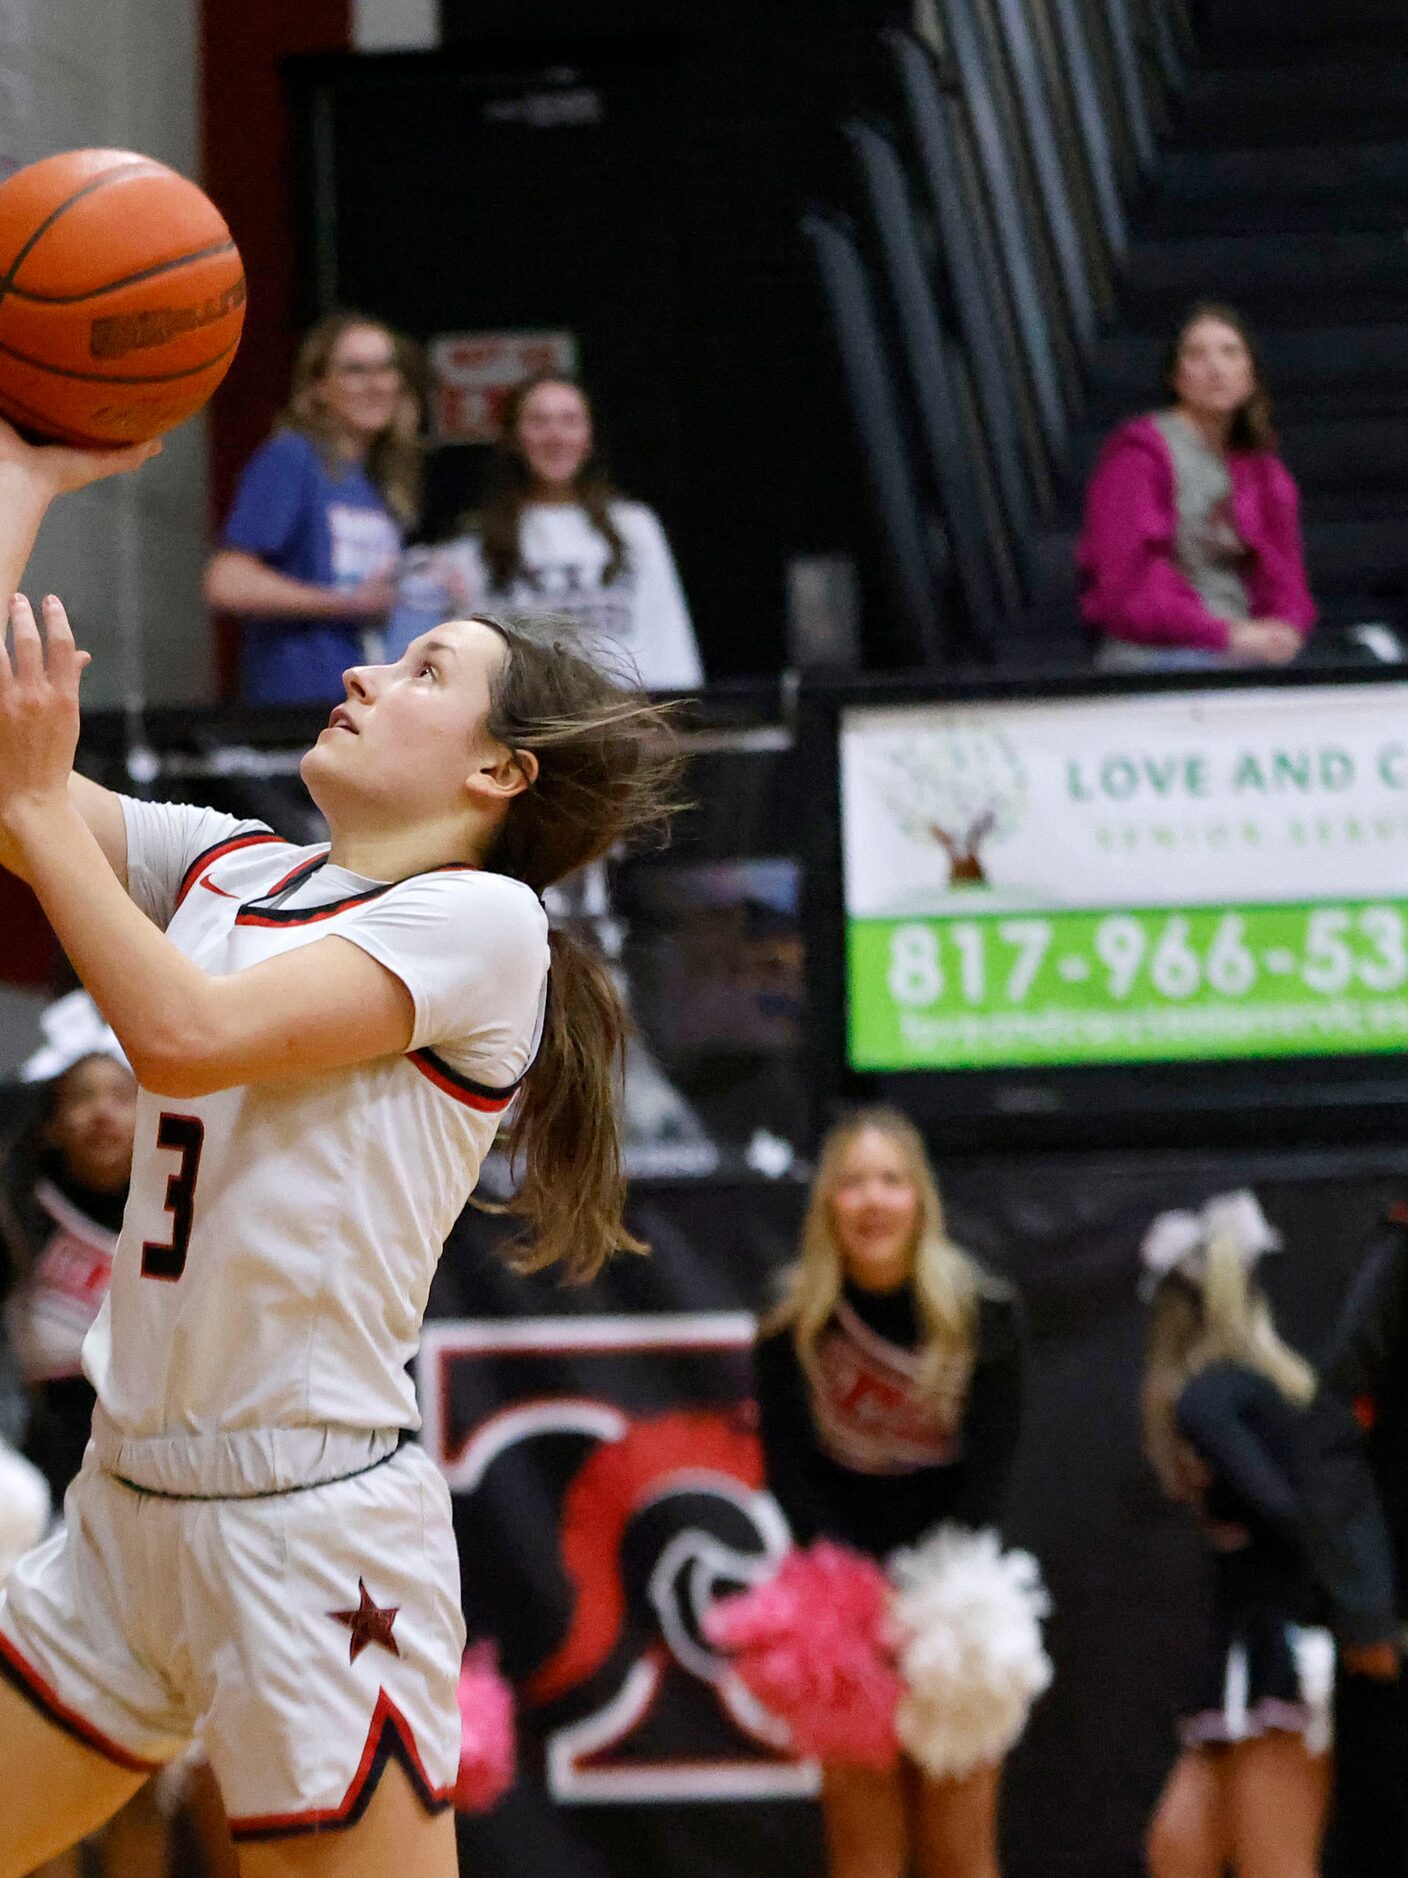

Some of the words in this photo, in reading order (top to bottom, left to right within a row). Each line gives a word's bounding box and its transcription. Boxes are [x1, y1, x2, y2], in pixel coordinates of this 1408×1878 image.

[1066, 753, 1209, 801] LOVE
[1233, 747, 1356, 793] AND
[140, 1112, 205, 1283] 3
